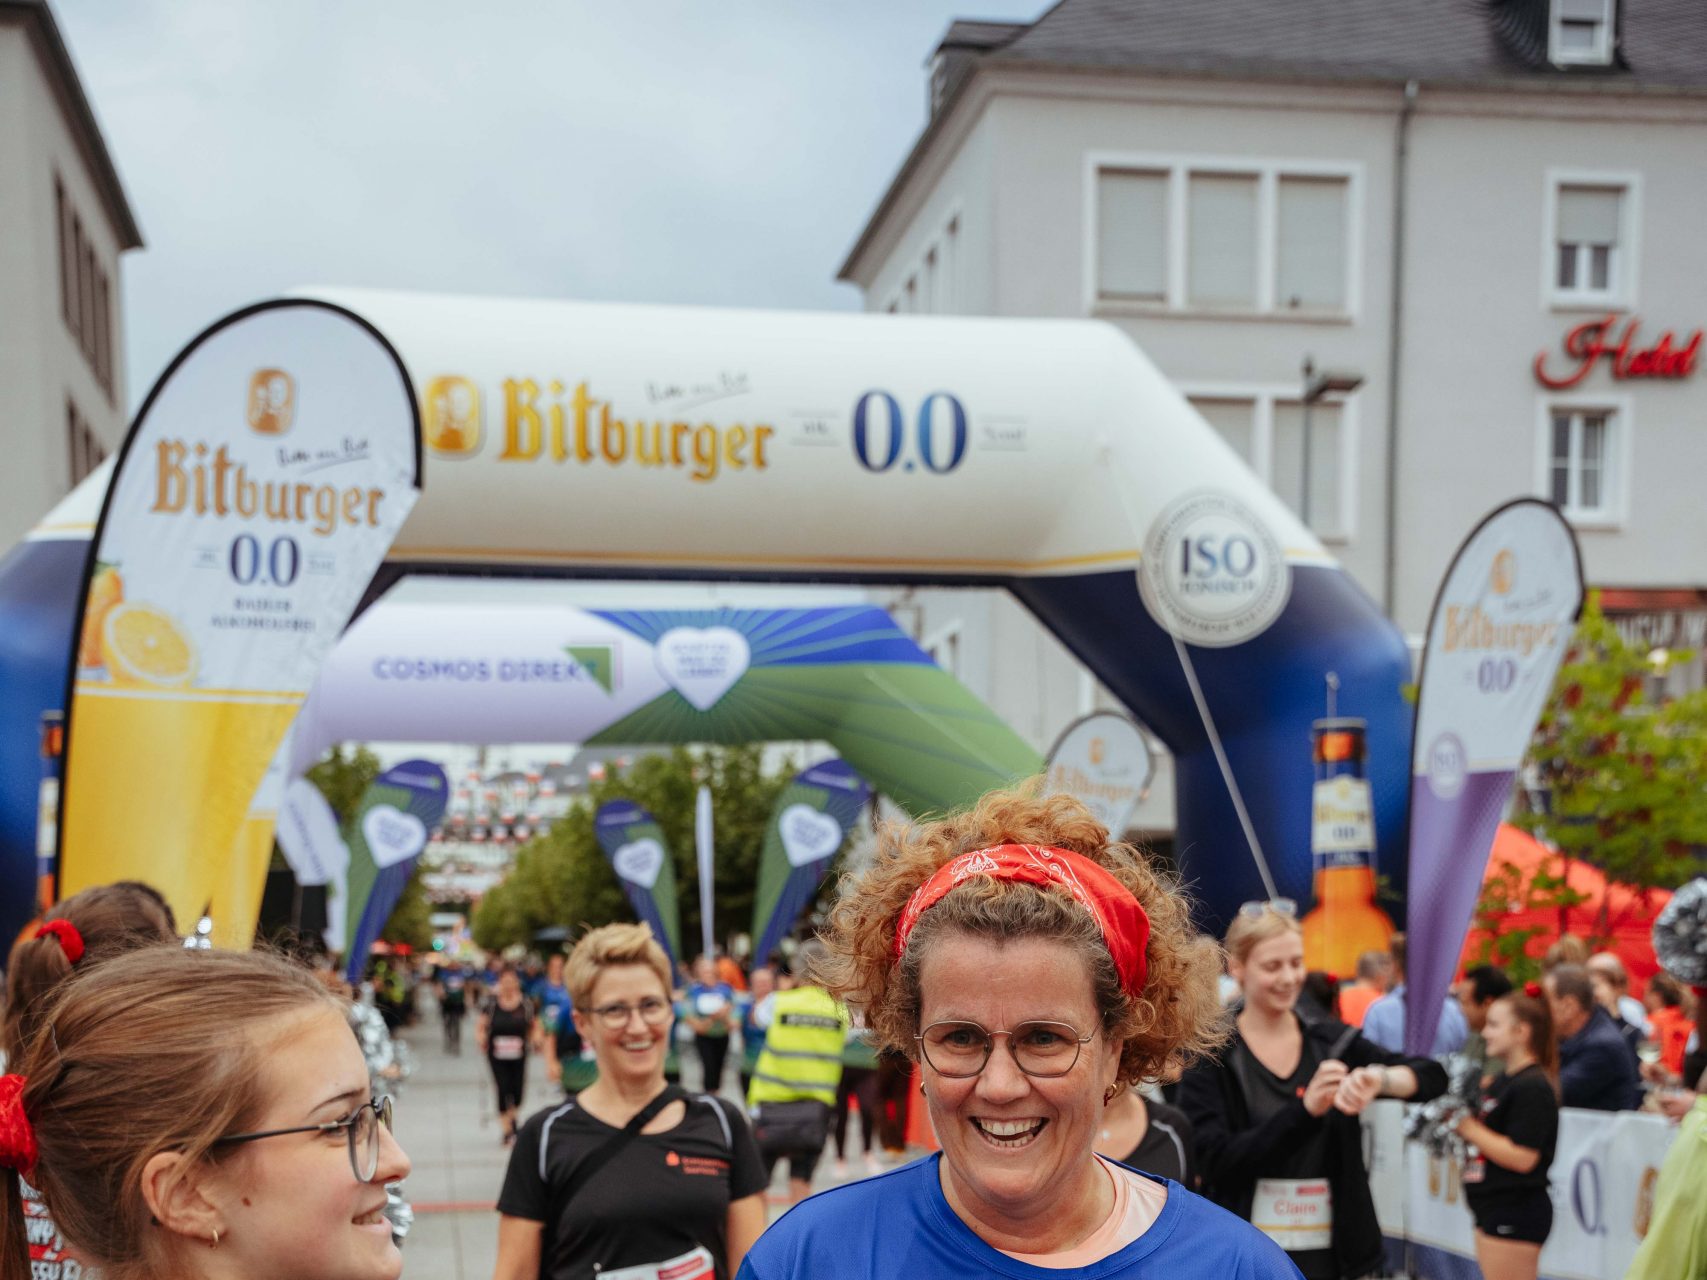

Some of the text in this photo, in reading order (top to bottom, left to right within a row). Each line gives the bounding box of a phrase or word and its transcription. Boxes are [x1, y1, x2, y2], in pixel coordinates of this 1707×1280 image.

[1533, 313, 1703, 390] Hotel
[499, 377, 774, 482] Bitburger
[853, 388, 967, 474] 0.0
[150, 438, 386, 537] Bitburger
[229, 533, 300, 587] 0.0
[1182, 535, 1256, 578] ISO
[373, 657, 490, 682] COSMOS
